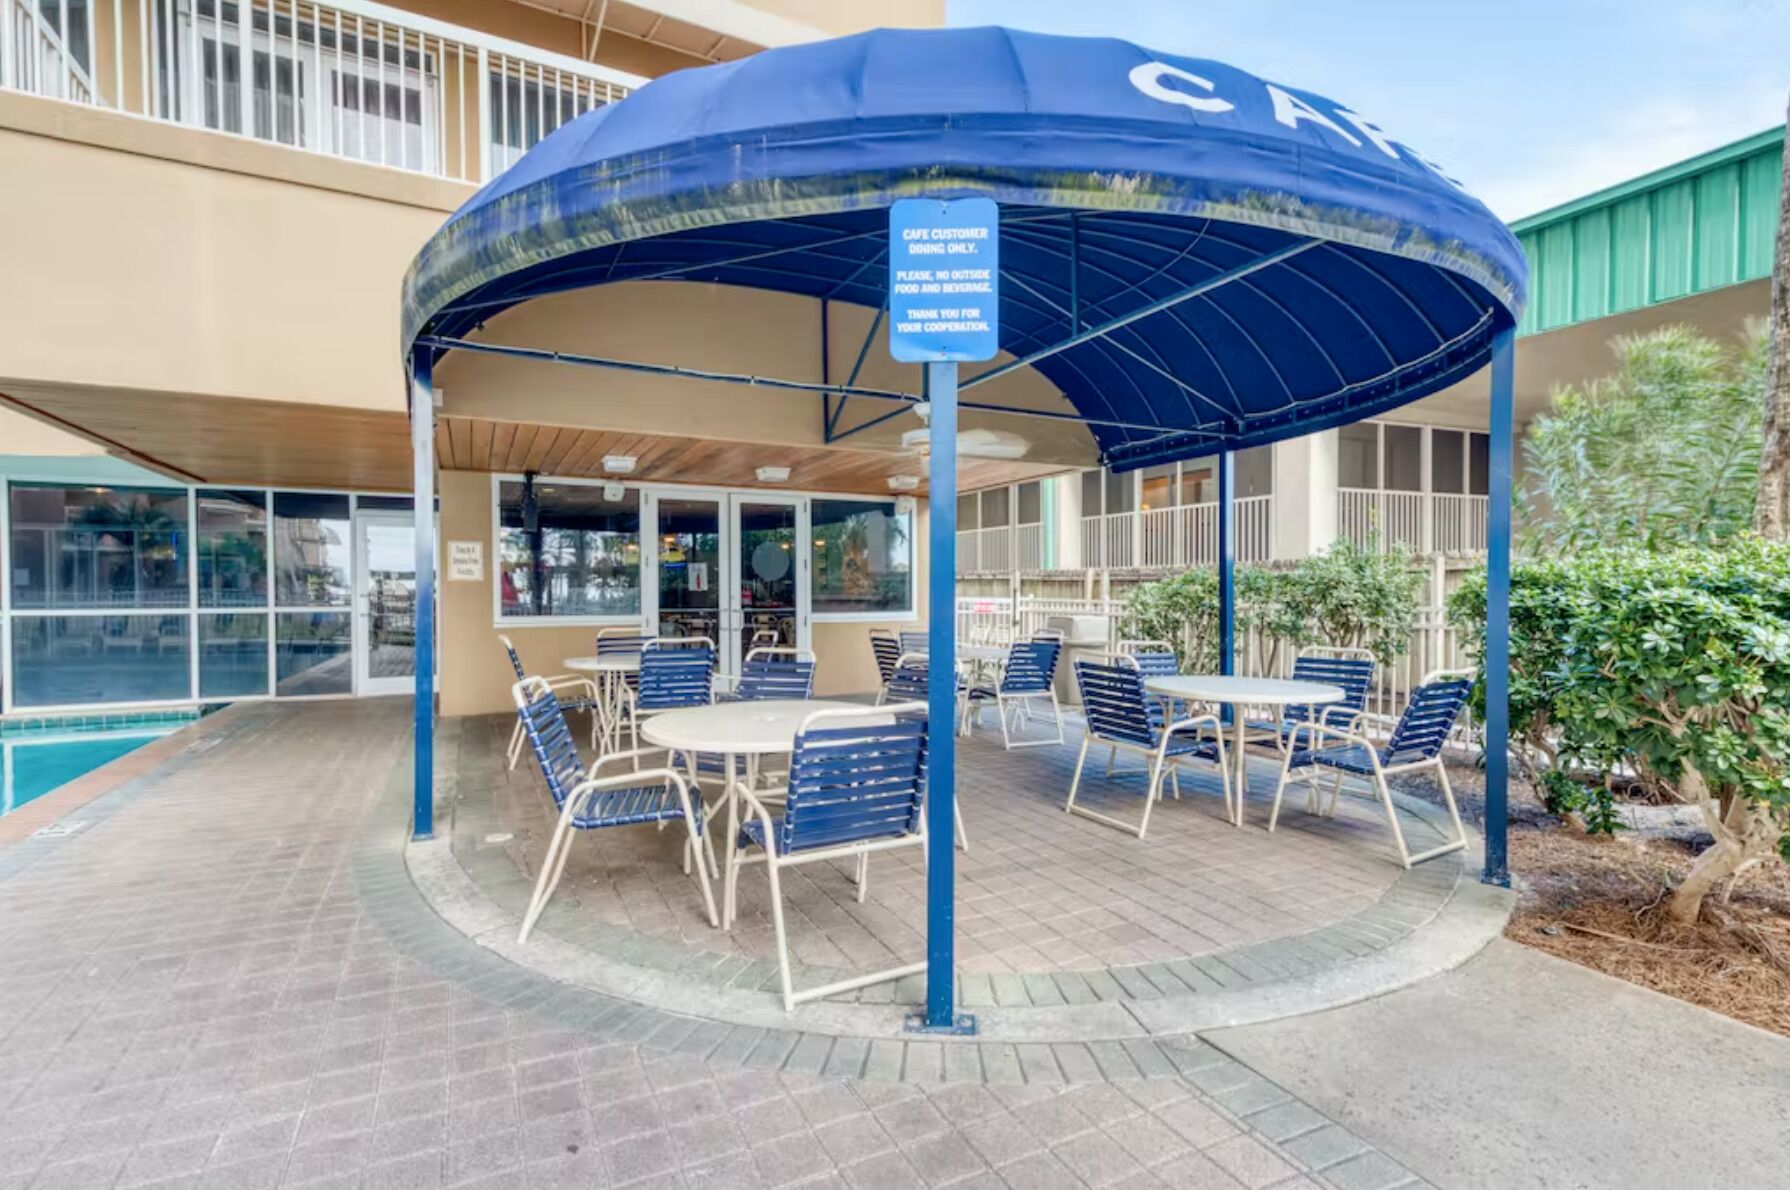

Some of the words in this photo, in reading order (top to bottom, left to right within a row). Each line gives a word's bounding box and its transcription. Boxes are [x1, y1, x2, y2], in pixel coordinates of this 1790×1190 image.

[903, 228, 930, 240] CAFE
[931, 228, 988, 240] CUSTOMER
[909, 243, 945, 254] DINING
[947, 243, 978, 254] ONLY.
[897, 270, 933, 282] PLEASE,
[936, 270, 949, 280] NO
[951, 269, 991, 280] OUTSIDE
[895, 284, 919, 294] FOOD
[920, 283, 941, 293] AND
[942, 282, 992, 293] BEVERAGE.
[907, 309, 938, 320] THANK
[940, 309, 960, 319] YOU
[961, 308, 980, 319] FOR
[897, 322, 922, 333] YOUR
[924, 322, 990, 333] COOPERATION.
